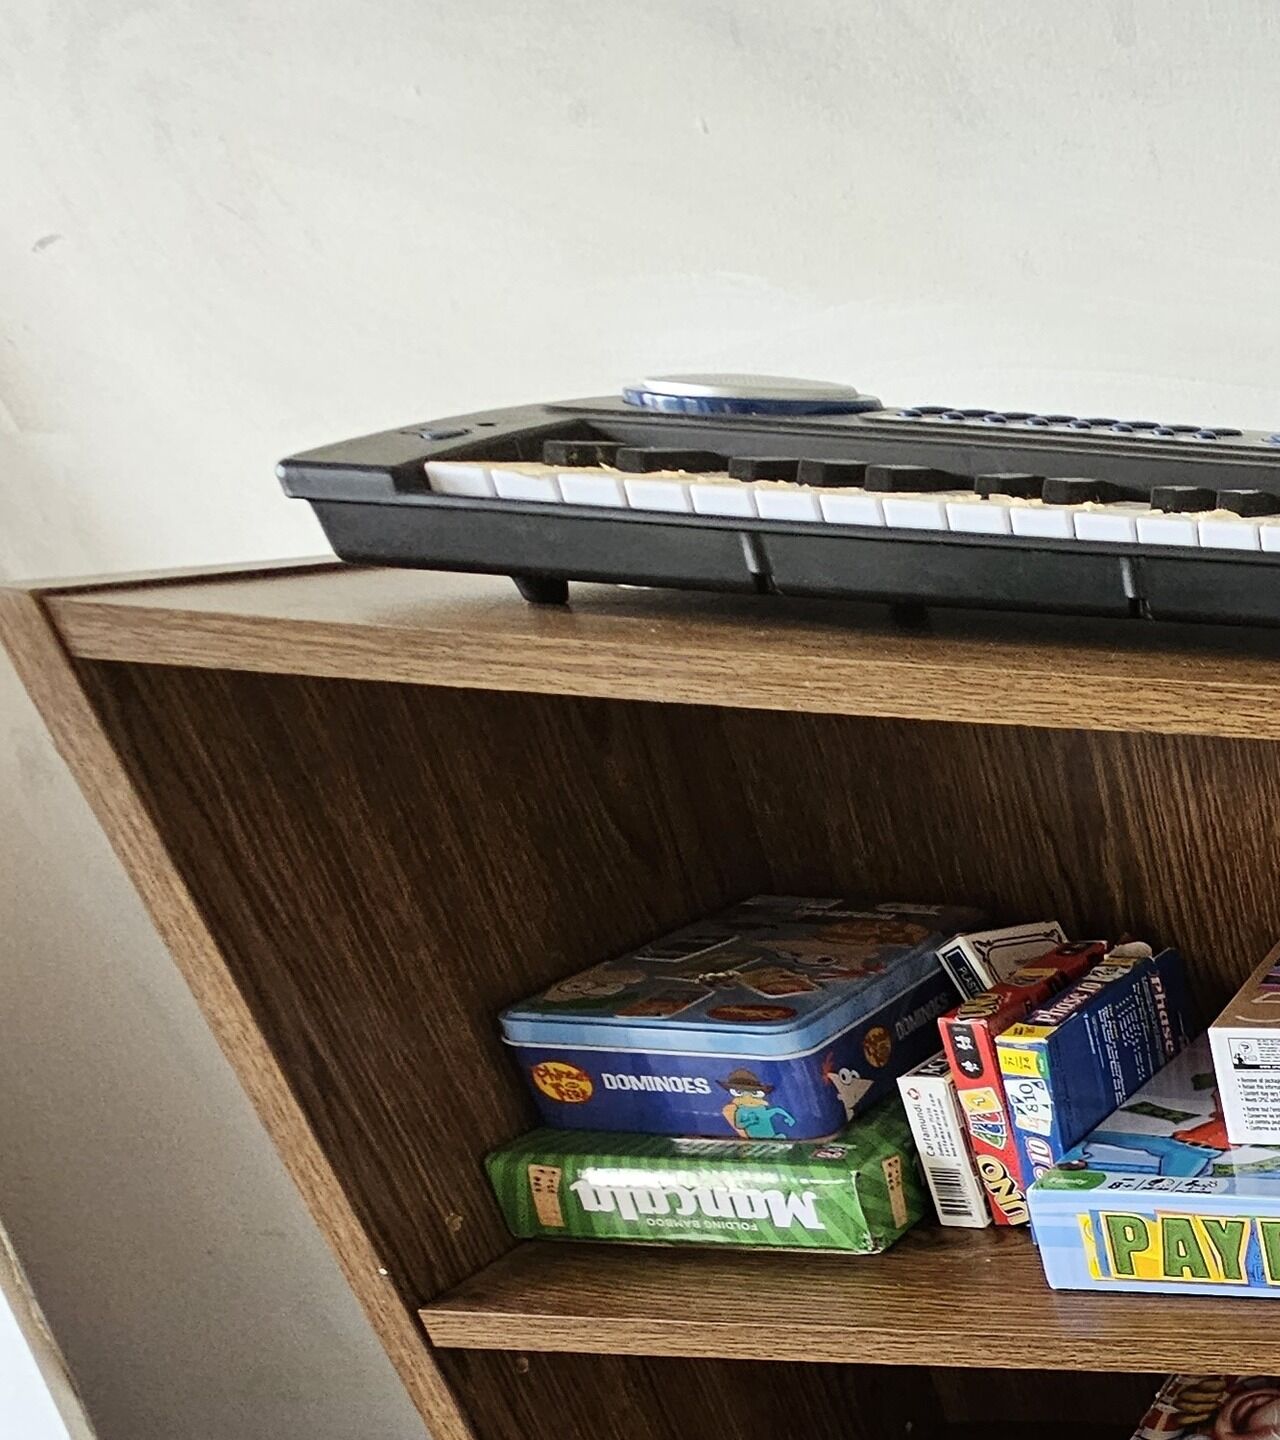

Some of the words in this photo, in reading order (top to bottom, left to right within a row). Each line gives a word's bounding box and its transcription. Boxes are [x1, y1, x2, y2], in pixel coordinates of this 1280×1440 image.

[602, 1072, 712, 1095] DOMINOES
[912, 1103, 936, 1158] Cartamundi
[570, 1179, 826, 1230] Mancala
[976, 1154, 1027, 1226] UNO
[646, 1217, 700, 1230] BAMBOO
[703, 1219, 758, 1232] FOLDING
